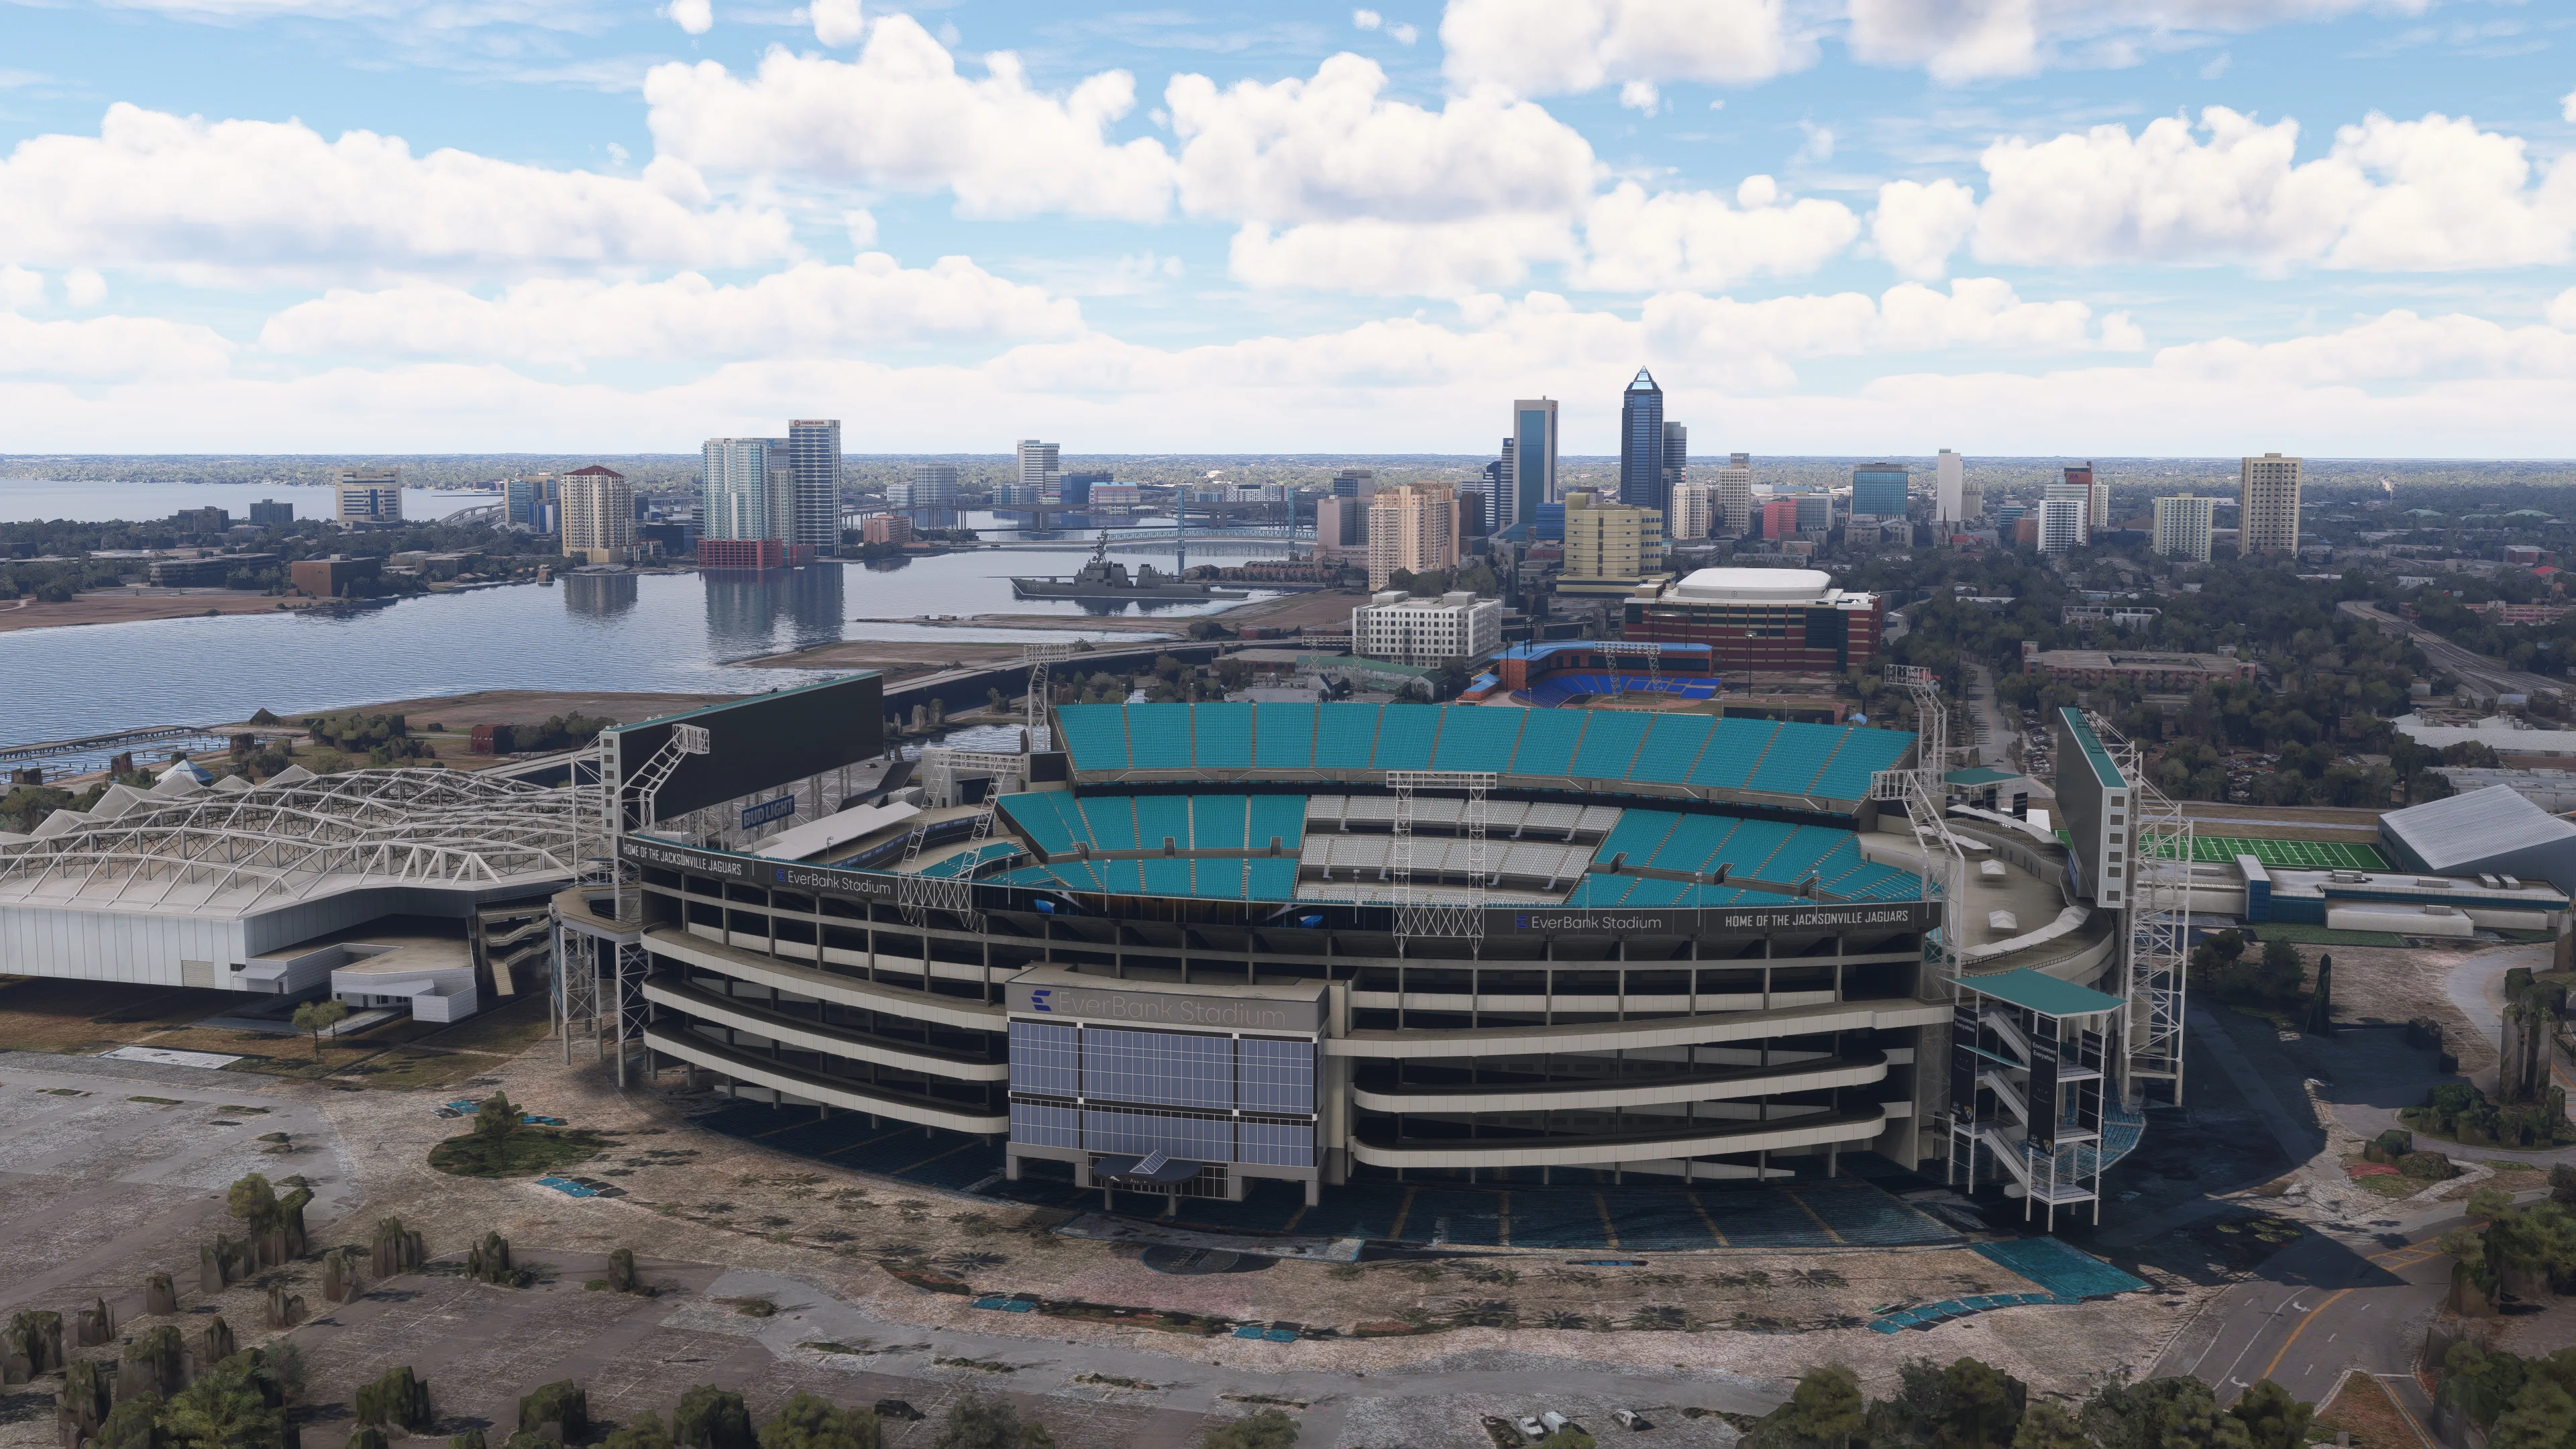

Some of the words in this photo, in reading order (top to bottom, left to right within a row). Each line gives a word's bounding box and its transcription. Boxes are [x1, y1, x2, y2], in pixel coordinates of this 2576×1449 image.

[743, 808, 765, 827] BUD
[765, 798, 793, 820] LIGHT
[623, 843, 639, 857] HOME
[640, 846, 647, 858] OF
[649, 848, 659, 861] THE
[661, 852, 706, 870] JACKSONVILLE
[708, 859, 742, 876] JAGUARS
[788, 870, 840, 889] EverBank
[842, 877, 891, 895] Stadium
[1532, 916, 1599, 929] EverBank
[1602, 916, 1662, 929] Stadium
[1725, 916, 1753, 927] HOME
[1756, 915, 1768, 926] OF
[1772, 914, 1790, 926] THE
[1792, 912, 1863, 926] JACKSONVILLE
[1865, 910, 1909, 924] JAGUARS
[1059, 991, 1173, 1020] EverBank
[1180, 1000, 1286, 1028] Stadium
[1954, 1013, 1976, 1026] Environment
[1955, 1020, 1976, 1034] Everywhere
[2032, 1041, 2057, 1057] Environment
[2033, 1049, 2055, 1063] Everywhere
